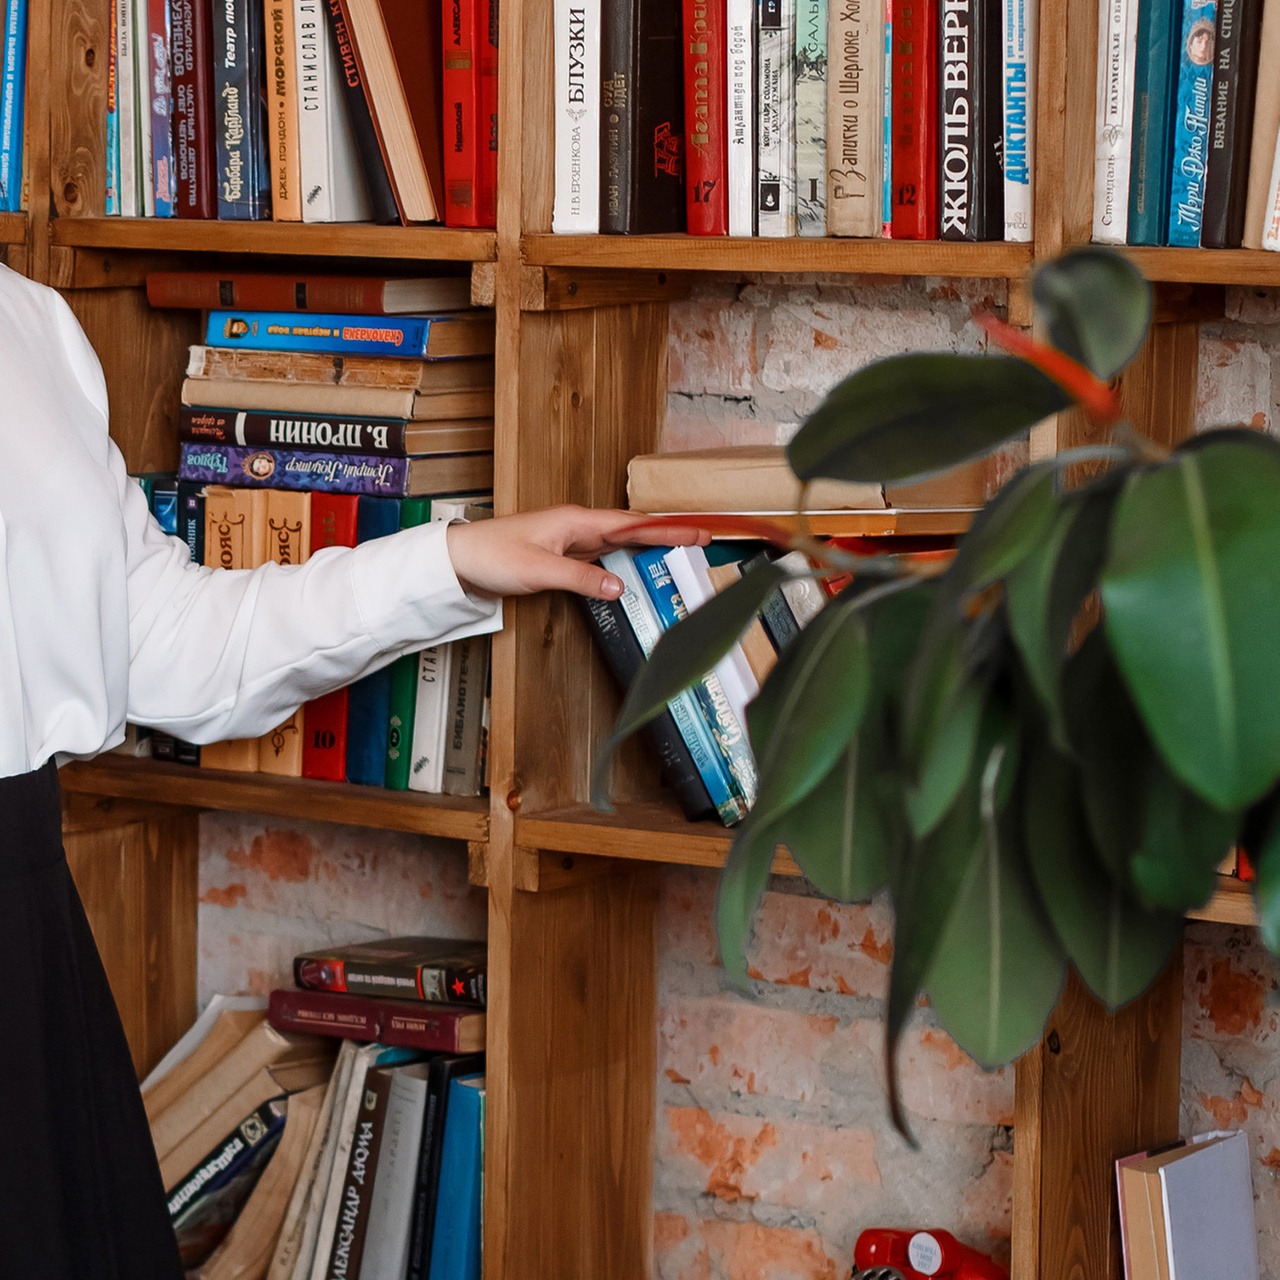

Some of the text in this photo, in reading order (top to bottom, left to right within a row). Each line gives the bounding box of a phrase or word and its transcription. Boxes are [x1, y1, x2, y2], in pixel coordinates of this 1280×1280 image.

[225, 24, 237, 69] Театр
[271, 7, 287, 97] МОРСКОЙ
[302, 22, 319, 111] СТАНИСЛАВ
[333, 20, 361, 88] СТИВЕН
[839, 29, 862, 96] Шерлоке
[1219, 47, 1231, 70] НА
[177, 84, 186, 113] ОЛЕГ
[568, 6, 586, 193] ЕРЗЕНКОВА БЛУЗКИ
[690, 58, 709, 159] Агата
[1005, 62, 1030, 186] ДИКТАНТЫ
[1213, 80, 1230, 150] ВЯЗАНИЕ
[277, 111, 287, 159] ЛОНДОН
[454, 101, 463, 153] Николай
[1101, 153, 1116, 226] Стендаль
[1110, 32, 1121, 115] ПАРМСКАЯ
[188, 147, 197, 207] ДЕТЕКТИВ
[223, 150, 244, 203] Барбара
[278, 162, 289, 200] ДЖЕК
[693, 179, 716, 204] 17
[942, 96, 970, 235] ЖЮЛЬ
[608, 182, 619, 217] ИВАН
[342, 327, 404, 347] Скалолазка
[269, 418, 389, 449] В. ПРОНИН
[313, 729, 337, 750] 10
[391, 733, 400, 745] 2
[352, 1120, 374, 1185] ДЮМА
